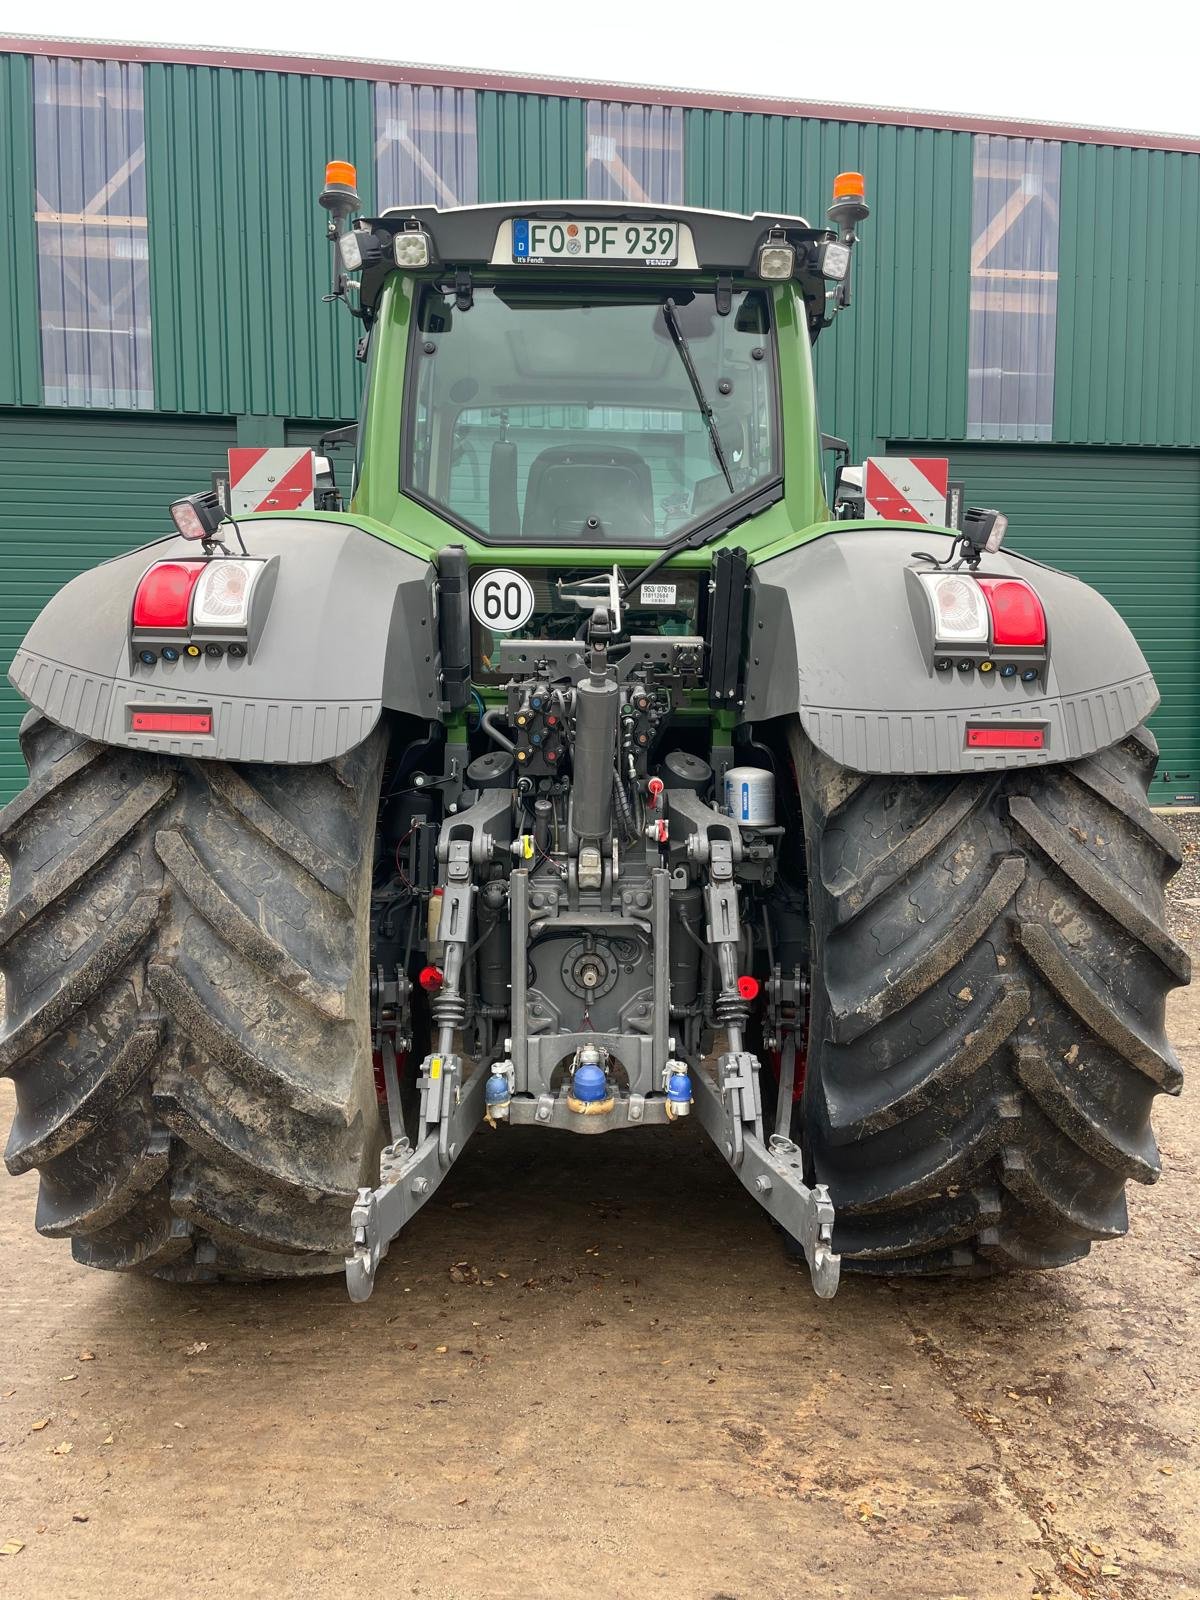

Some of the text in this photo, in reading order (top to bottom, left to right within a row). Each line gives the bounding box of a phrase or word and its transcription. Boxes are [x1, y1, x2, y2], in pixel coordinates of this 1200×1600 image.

[518, 242, 525, 251] D
[531, 225, 674, 255] FO PF 939
[484, 581, 521, 620] 60
